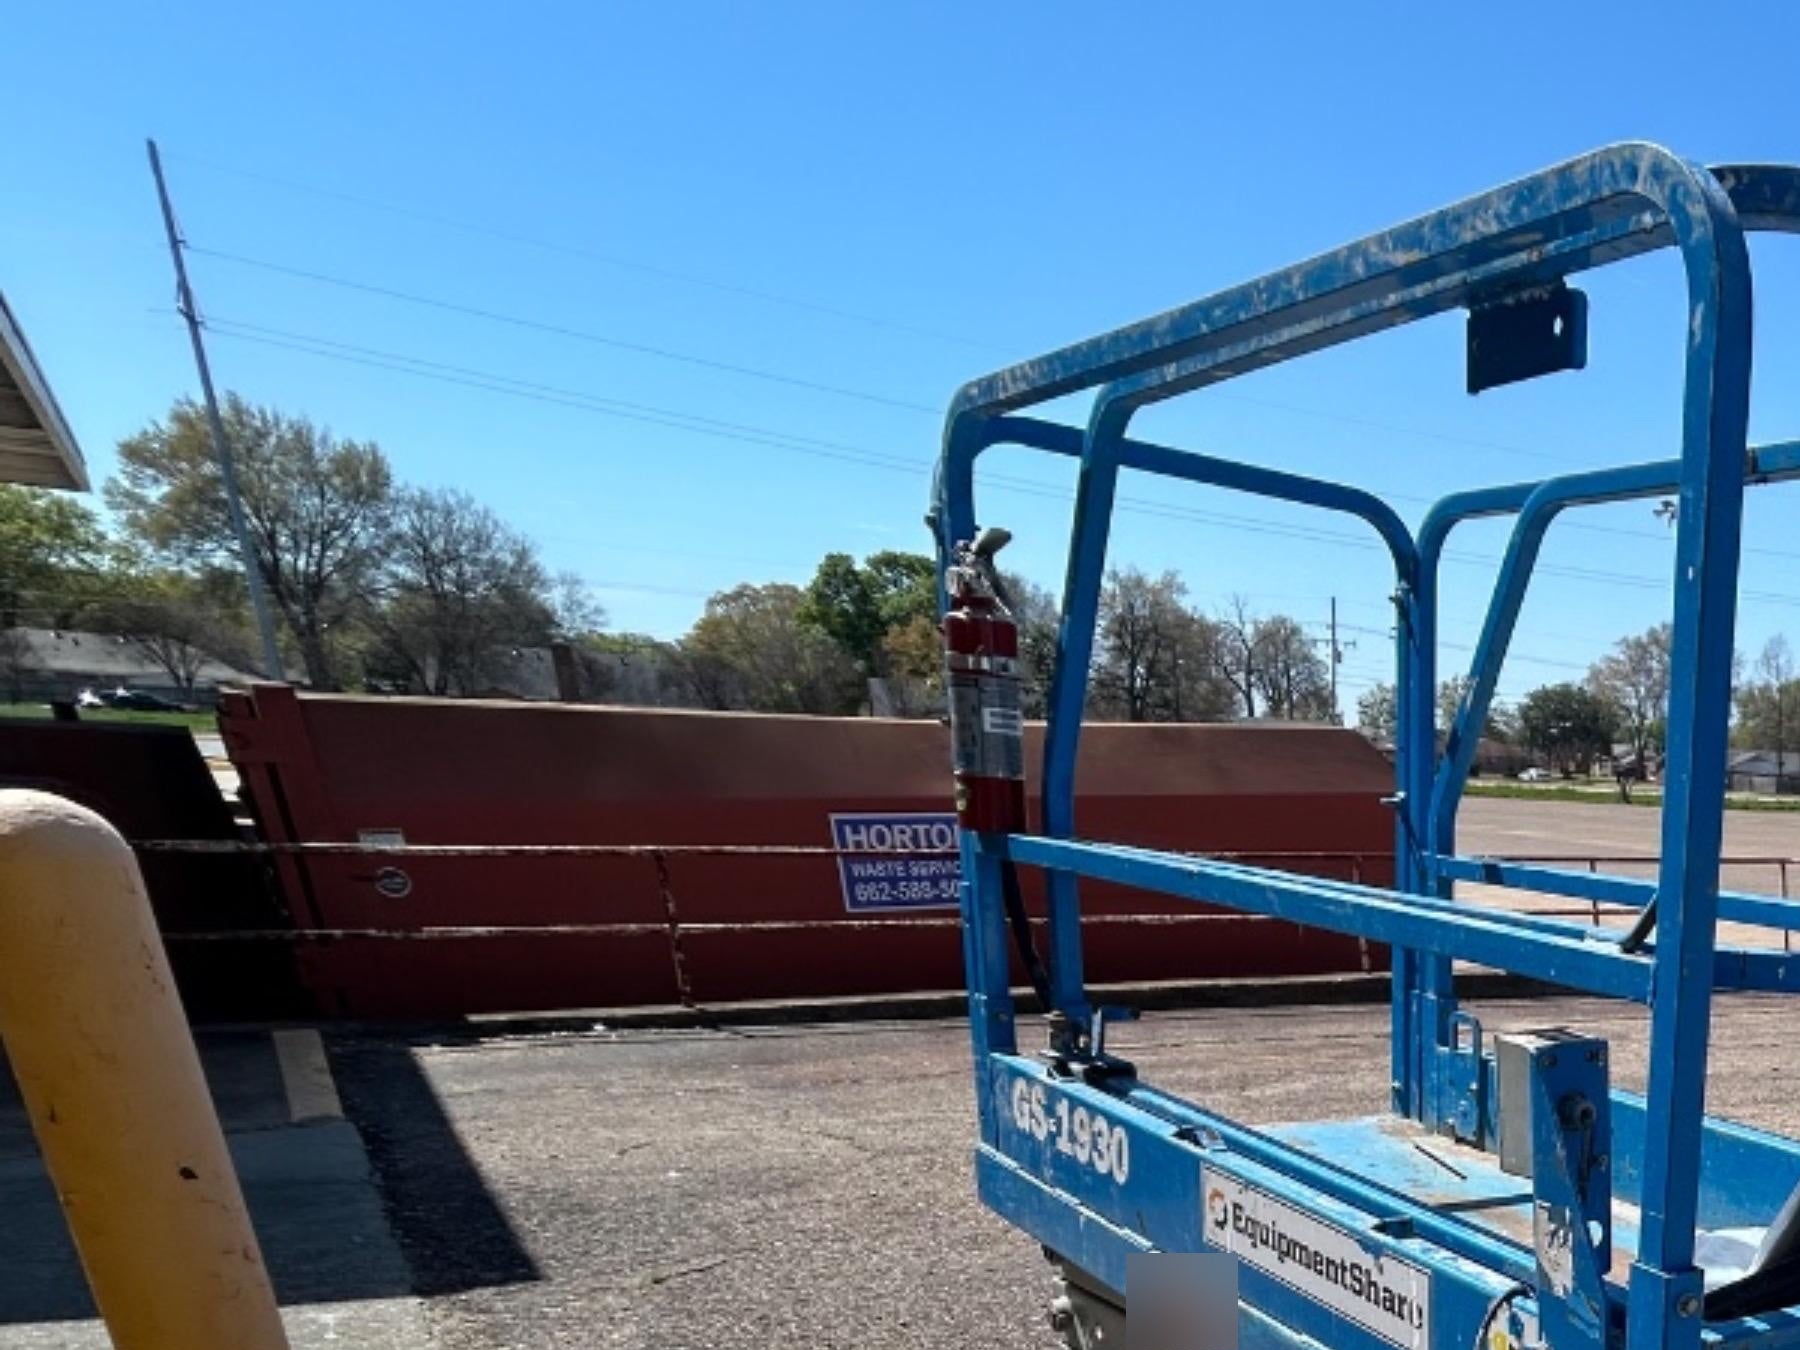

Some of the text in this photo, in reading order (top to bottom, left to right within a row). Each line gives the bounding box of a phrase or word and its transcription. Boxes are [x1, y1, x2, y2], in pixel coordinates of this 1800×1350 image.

[850, 861, 906, 877] WASTE
[1012, 1077, 1130, 1185] GS-1930
[1231, 1202, 1423, 1329] EquipmentShare
